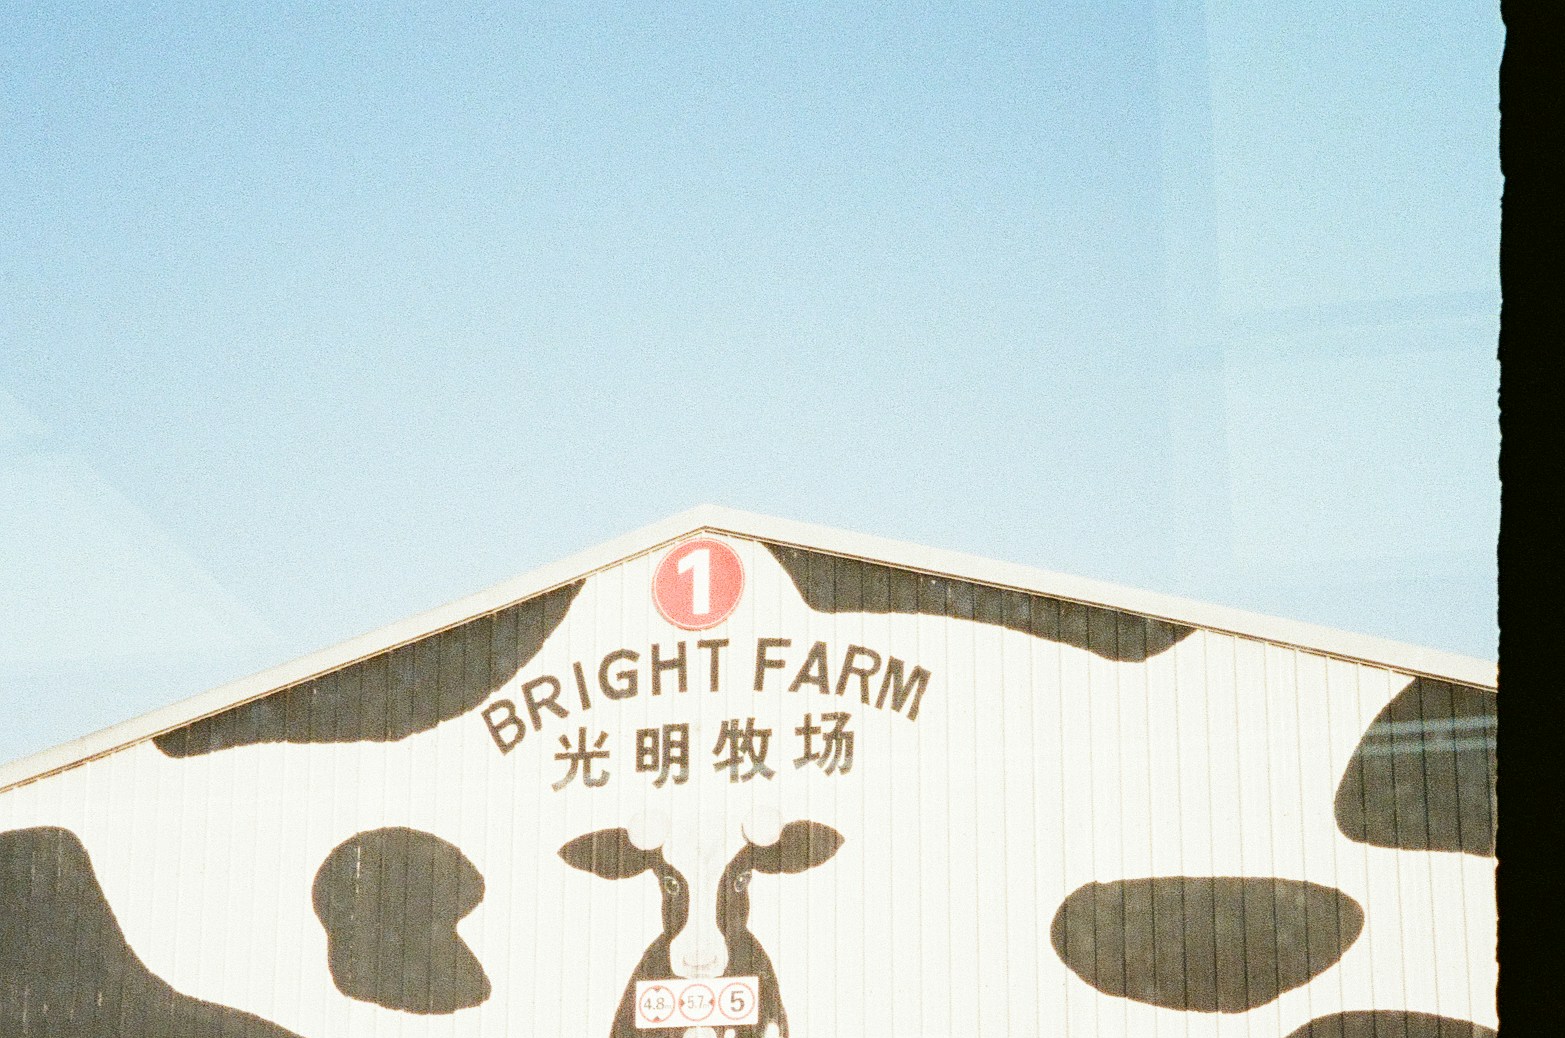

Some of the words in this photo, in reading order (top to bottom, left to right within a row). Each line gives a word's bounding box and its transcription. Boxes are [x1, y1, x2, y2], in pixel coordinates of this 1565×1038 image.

[677, 548, 711, 615] 1
[481, 638, 730, 757] BRIGHT
[753, 637, 933, 723] FARM
[551, 711, 856, 793] 光明牧场
[730, 990, 745, 1012] 5
